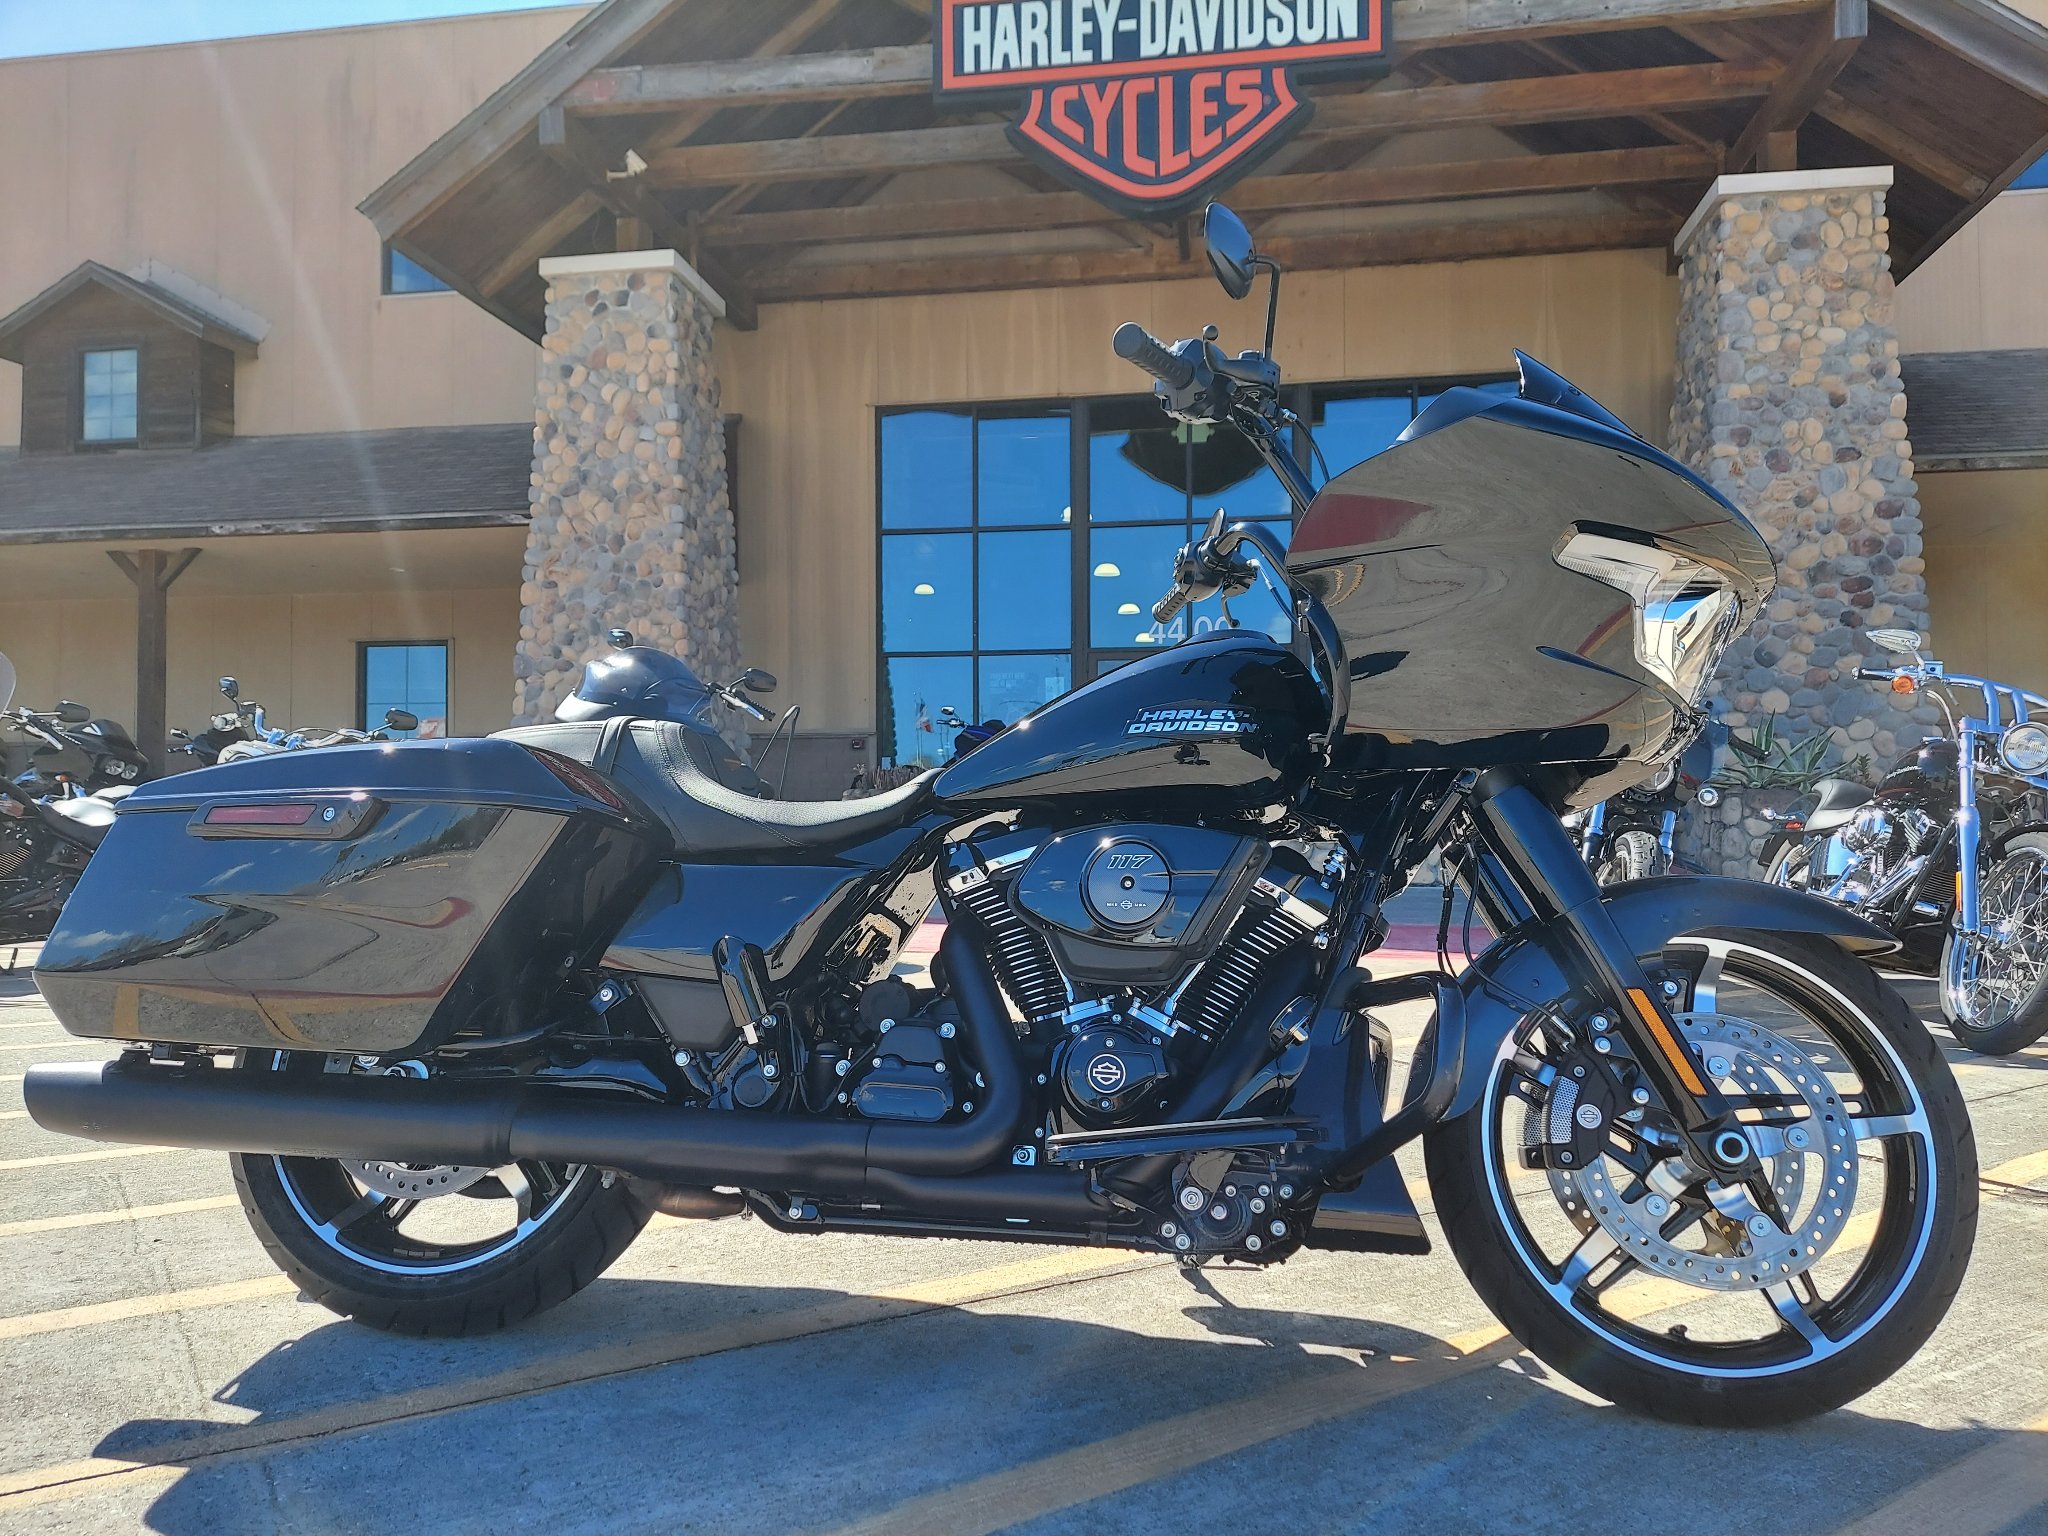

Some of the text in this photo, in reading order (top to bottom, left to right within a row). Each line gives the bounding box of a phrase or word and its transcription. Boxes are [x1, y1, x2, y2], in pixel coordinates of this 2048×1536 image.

[962, 0, 1358, 74] HARLEY-DAVIDSON
[1050, 68, 1263, 178] CYCLES
[1127, 721, 1258, 734] DAVIDSON
[1106, 854, 1153, 869] 117
